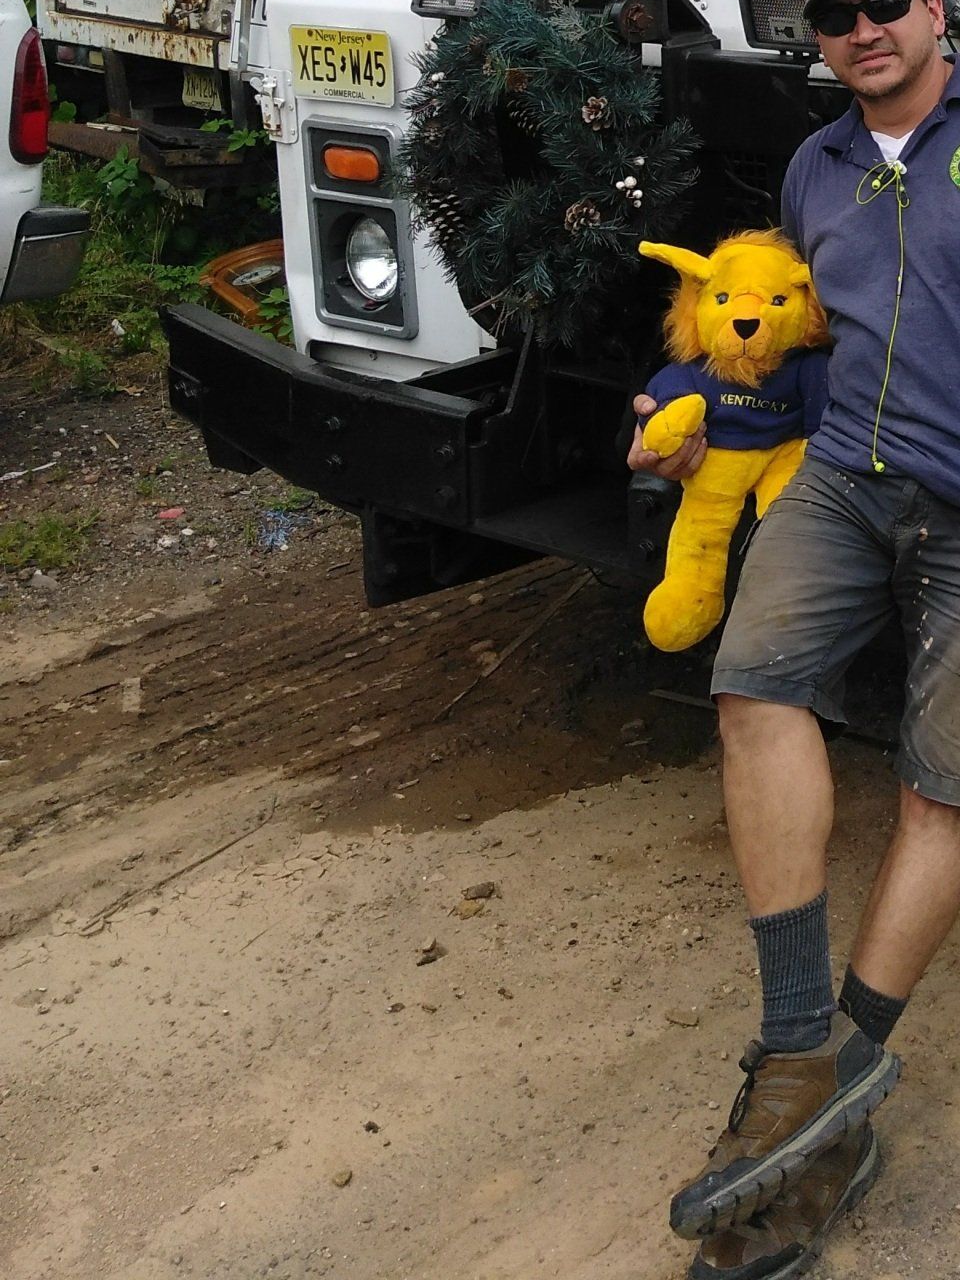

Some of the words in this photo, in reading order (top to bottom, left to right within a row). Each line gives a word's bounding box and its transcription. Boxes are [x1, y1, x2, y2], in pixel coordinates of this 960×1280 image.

[315, 29, 336, 42] New
[338, 31, 366, 47] Jersey
[297, 45, 337, 83] XES
[349, 48, 386, 88] W45
[323, 88, 366, 100] COMMERCIAL
[719, 393, 788, 413] KENTUCKY
